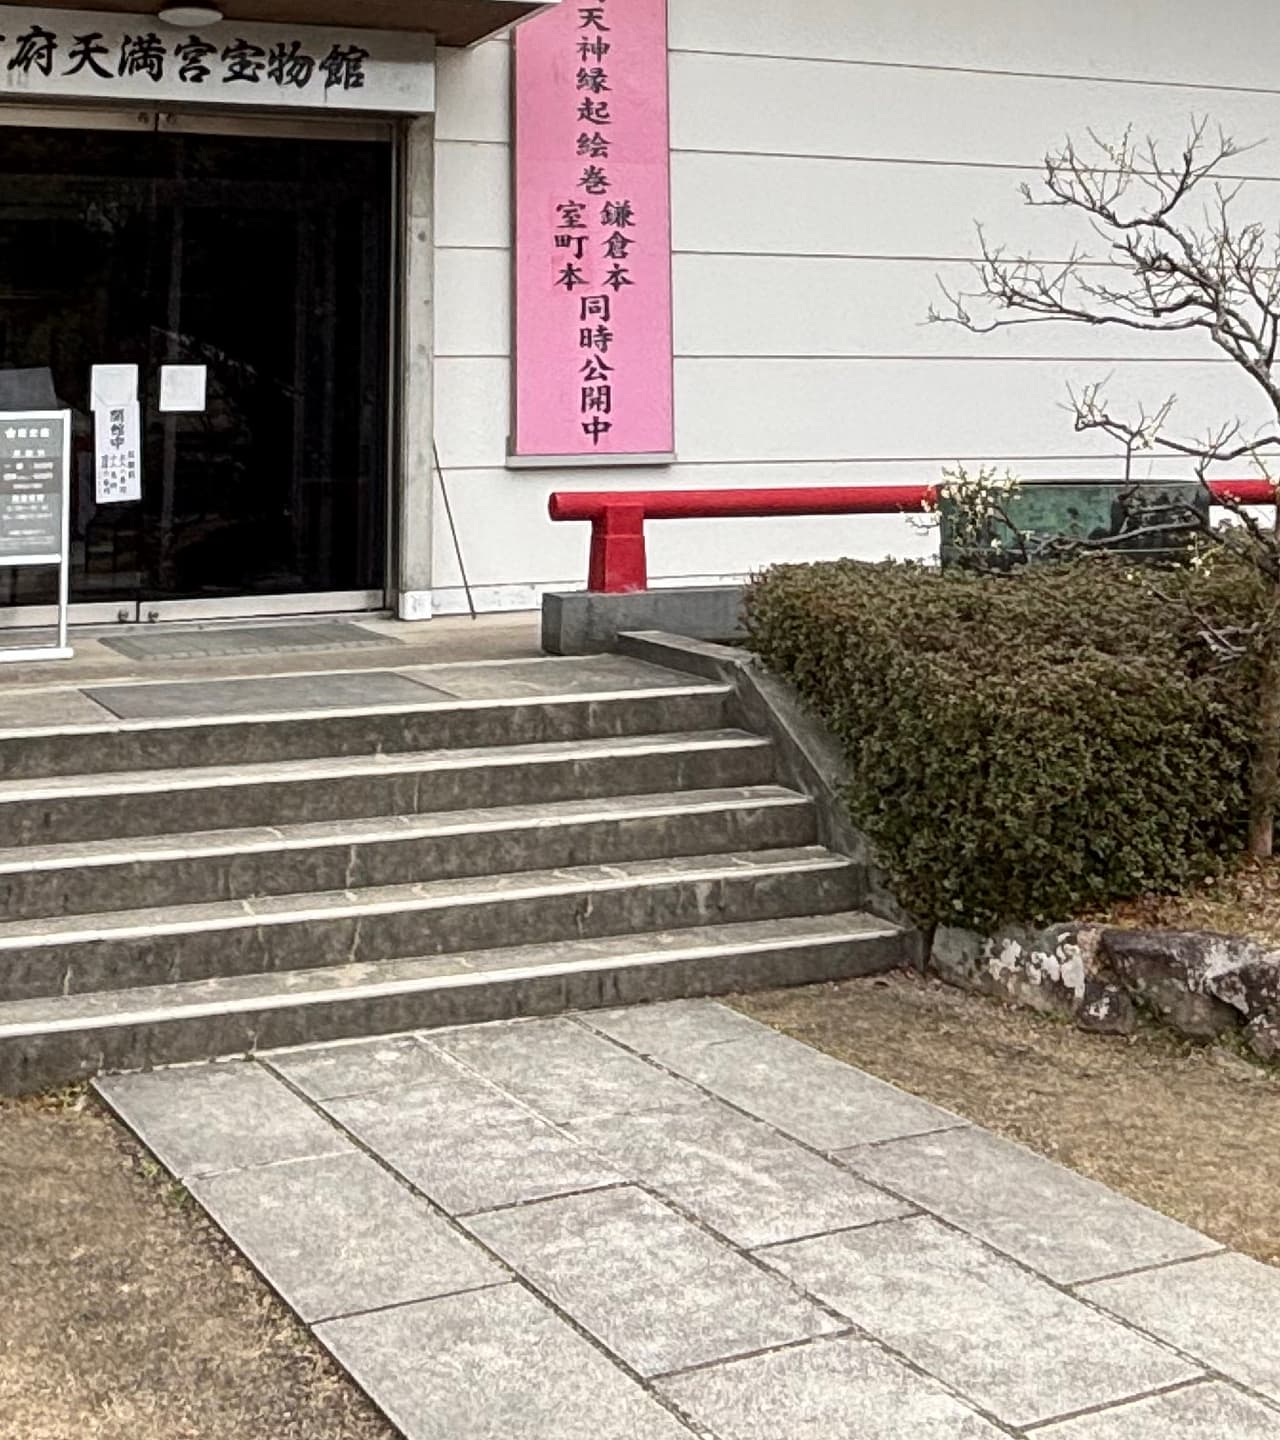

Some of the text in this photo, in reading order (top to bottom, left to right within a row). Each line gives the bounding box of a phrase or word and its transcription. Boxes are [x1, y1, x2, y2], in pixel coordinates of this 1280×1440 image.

[554, 201, 589, 291] 室町本
[601, 201, 636, 292] 鎌倉本
[579, 295, 615, 445] 同時公開中
